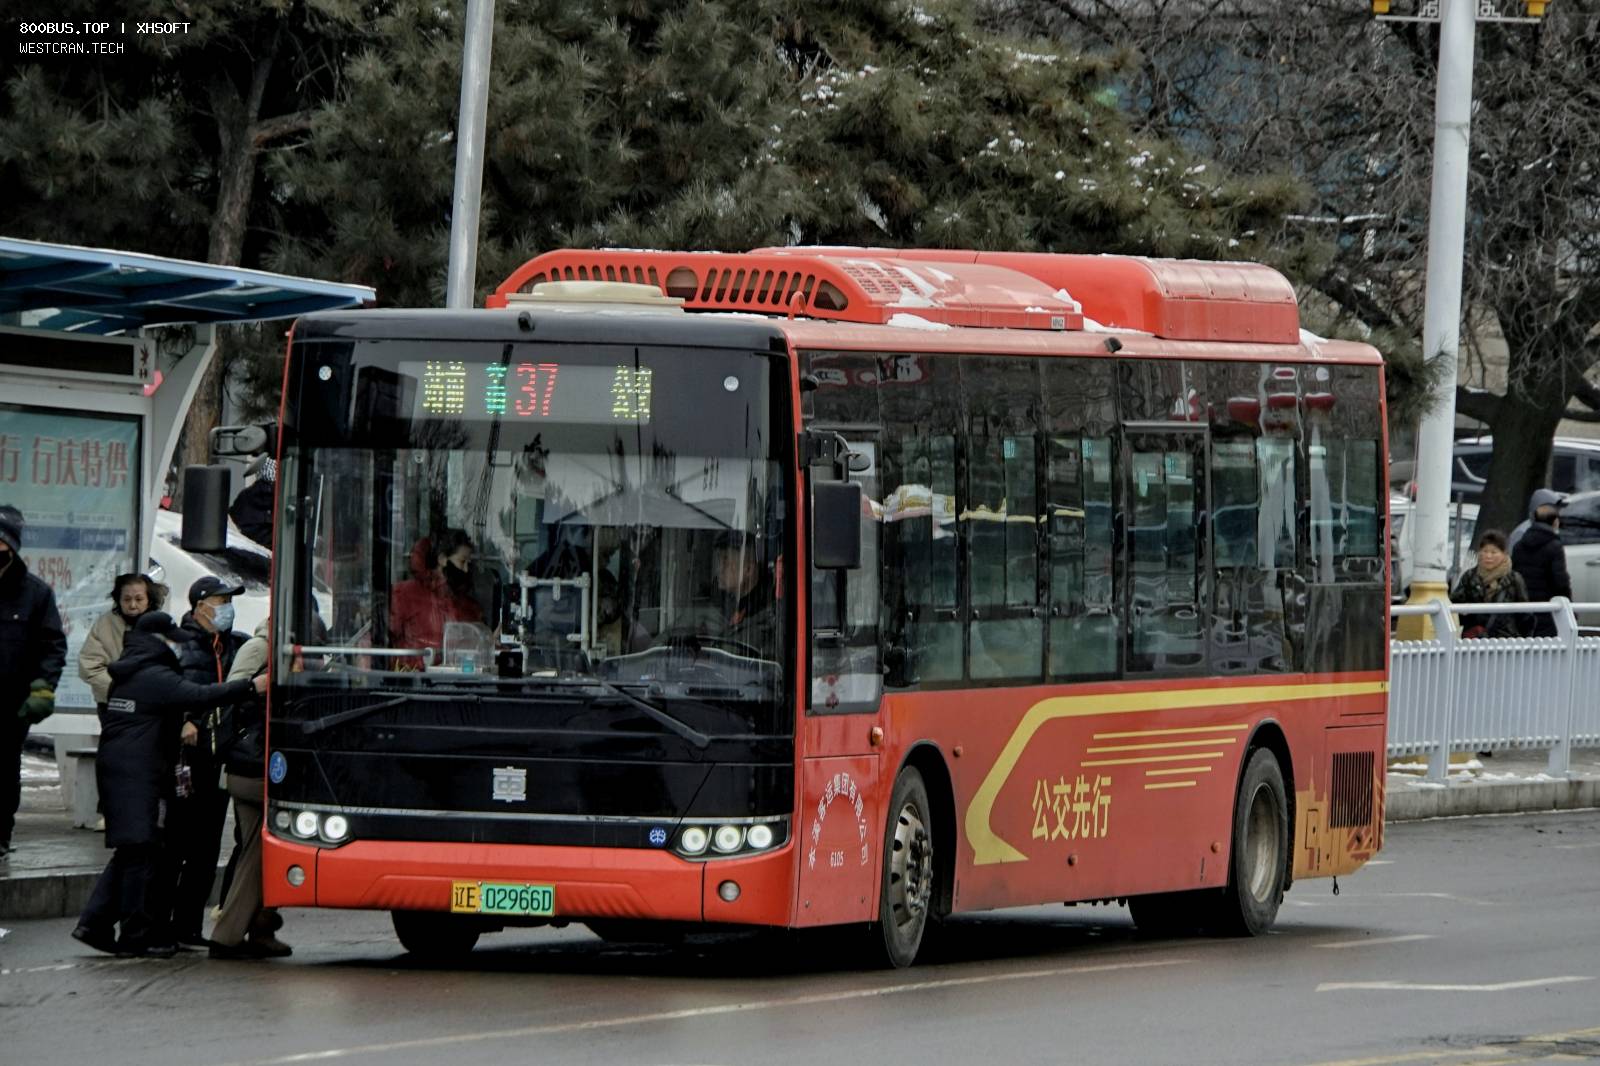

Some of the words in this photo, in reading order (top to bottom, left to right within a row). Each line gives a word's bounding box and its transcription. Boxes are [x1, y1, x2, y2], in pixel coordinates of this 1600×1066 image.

[515, 363, 559, 416] 37
[1032, 774, 1112, 841] 公交先行
